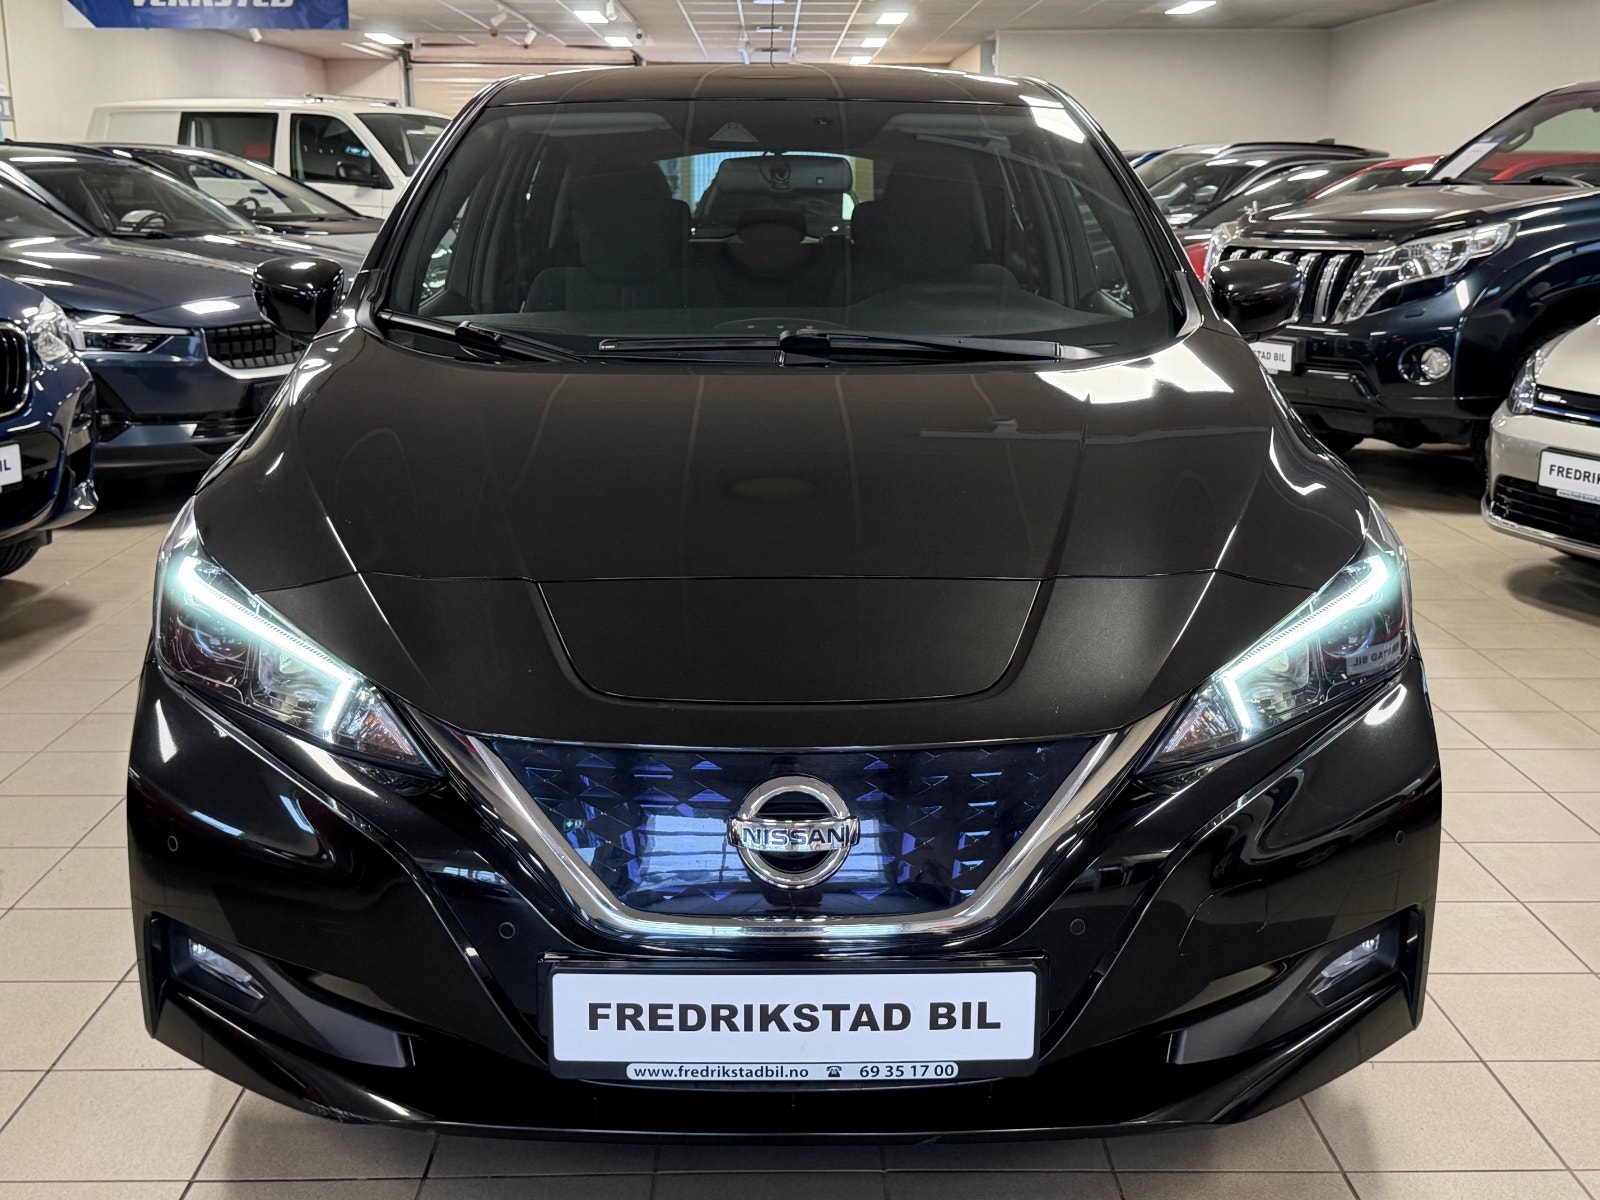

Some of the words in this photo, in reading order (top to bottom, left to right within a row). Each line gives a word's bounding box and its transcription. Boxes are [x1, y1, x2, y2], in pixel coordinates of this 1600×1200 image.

[1253, 350, 1272, 360] TAD
[1273, 352, 1287, 362] BIL
[742, 826, 846, 846] NISSAN
[588, 1002, 912, 1032] FREDRIKSTAD
[929, 1001, 1001, 1031] BIL
[634, 1065, 809, 1078] www.fredrikstadbil.no
[859, 1064, 880, 1078] 69
[884, 1064, 905, 1078] 35
[910, 1064, 930, 1078] 17
[934, 1064, 955, 1077] 00
